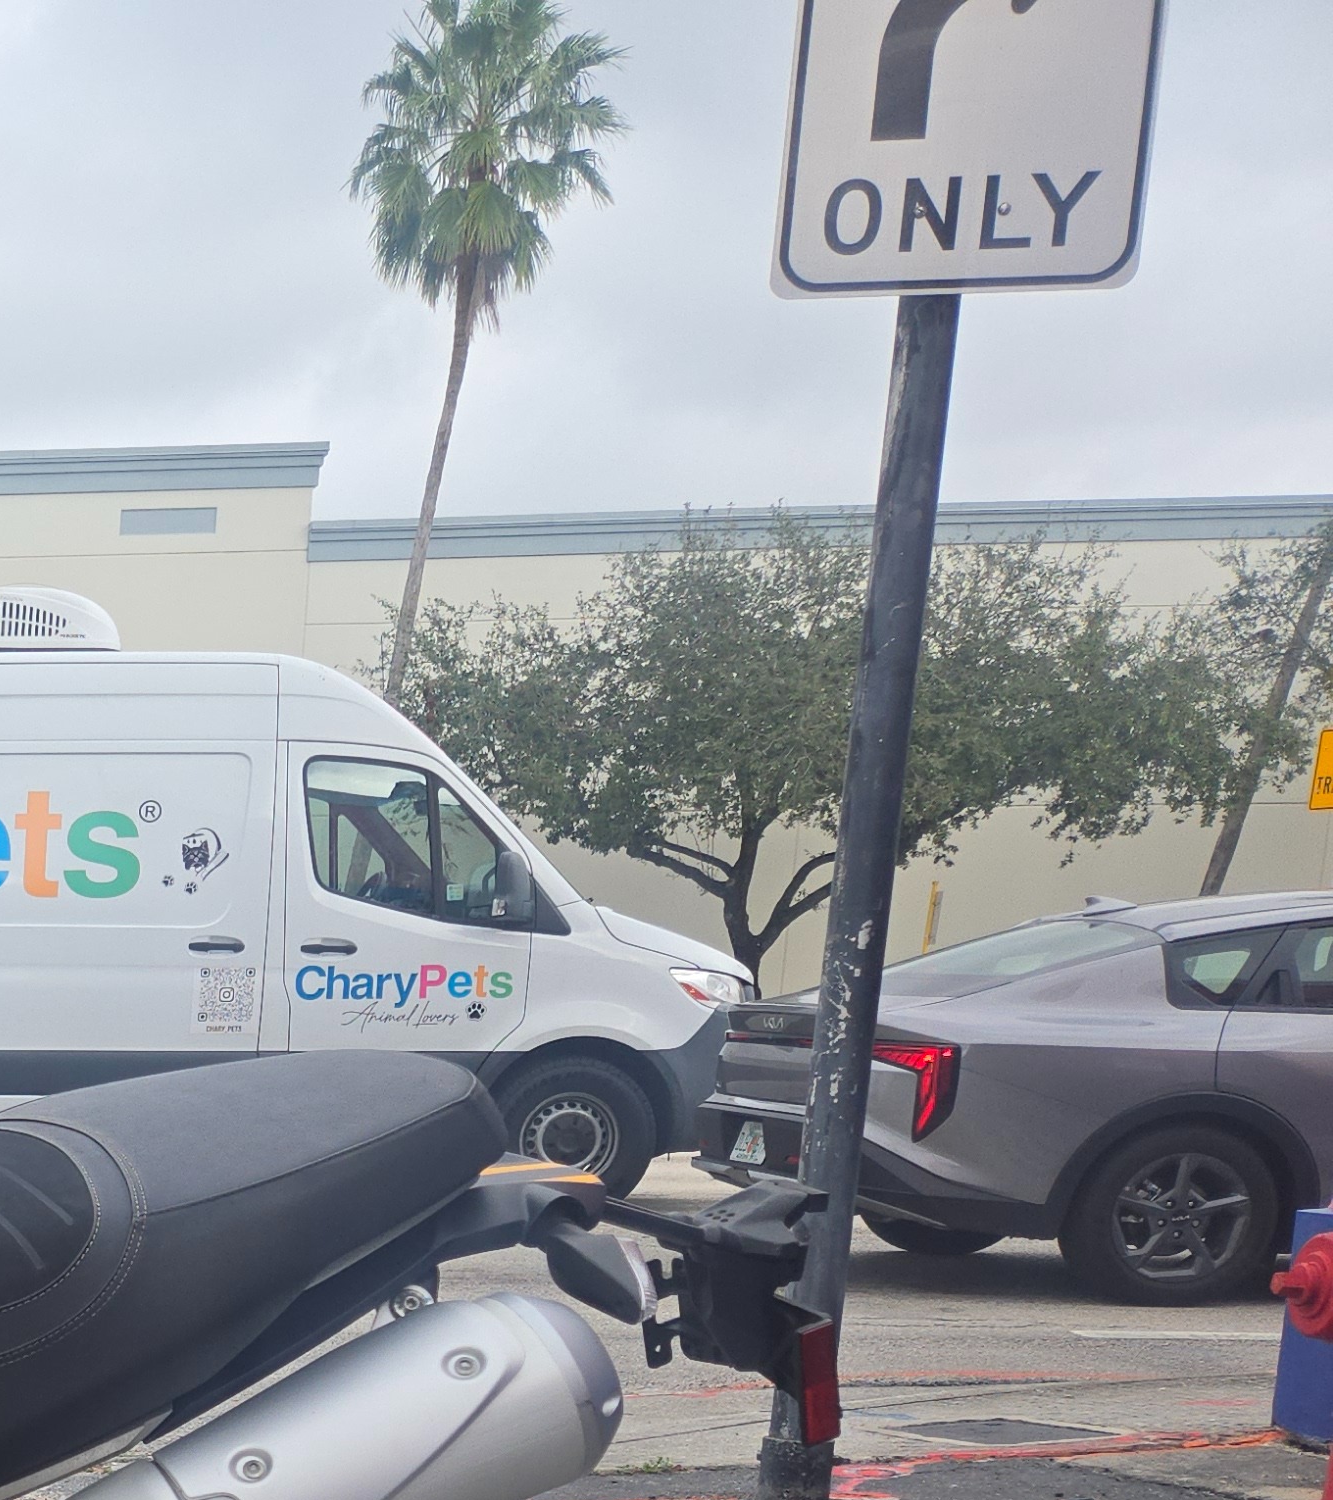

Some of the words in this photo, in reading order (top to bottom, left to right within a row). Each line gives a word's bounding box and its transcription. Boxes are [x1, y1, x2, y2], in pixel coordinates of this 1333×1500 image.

[823, 169, 1103, 256] ONLY
[1316, 776, 1333, 795] TR
[294, 964, 514, 1009] CharyPets
[341, 1001, 414, 1034] Animal
[413, 1001, 460, 1028] Lovers
